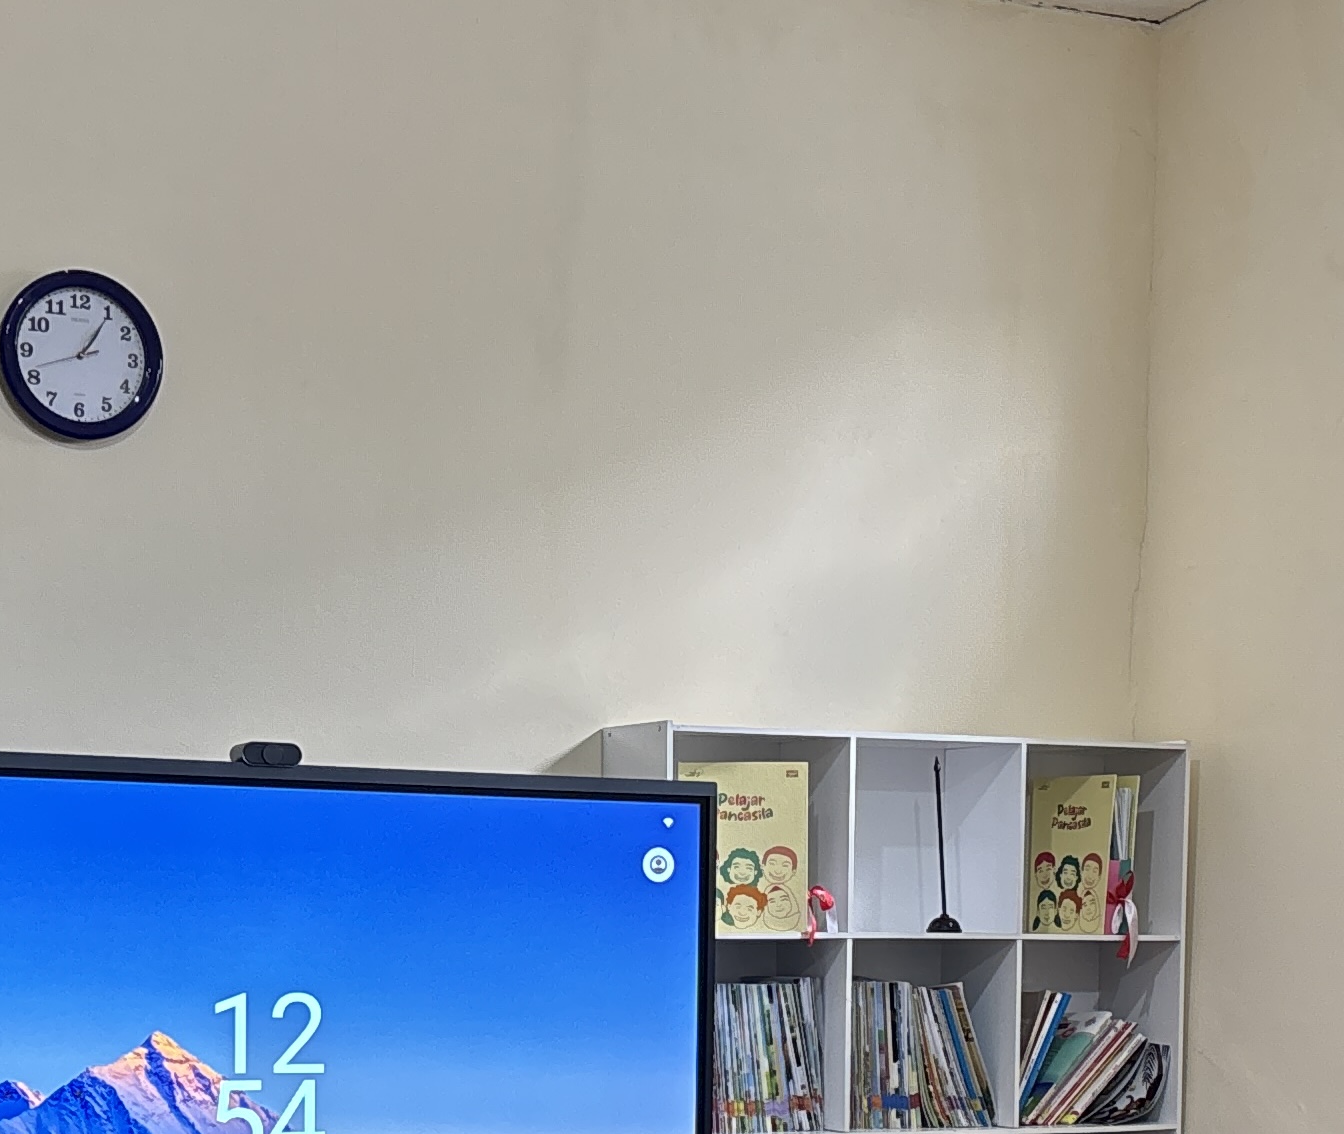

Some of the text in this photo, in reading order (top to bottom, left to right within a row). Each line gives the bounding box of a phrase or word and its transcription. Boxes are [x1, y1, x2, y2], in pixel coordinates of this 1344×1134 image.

[45, 299, 66, 316] 11
[70, 294, 91, 310] 12
[104, 306, 113, 321] 1
[28, 317, 49, 333] 10
[120, 326, 131, 342] 2
[20, 342, 33, 358] 9
[128, 354, 138, 369] 3
[27, 369, 41, 385] 8
[120, 379, 130, 394] 4
[46, 391, 57, 407] 7
[102, 397, 112, 412] 5
[74, 402, 85, 417] 6
[718, 793, 766, 811] Pelajar
[717, 808, 774, 821] ancasila
[214, 992, 324, 1074] 12
